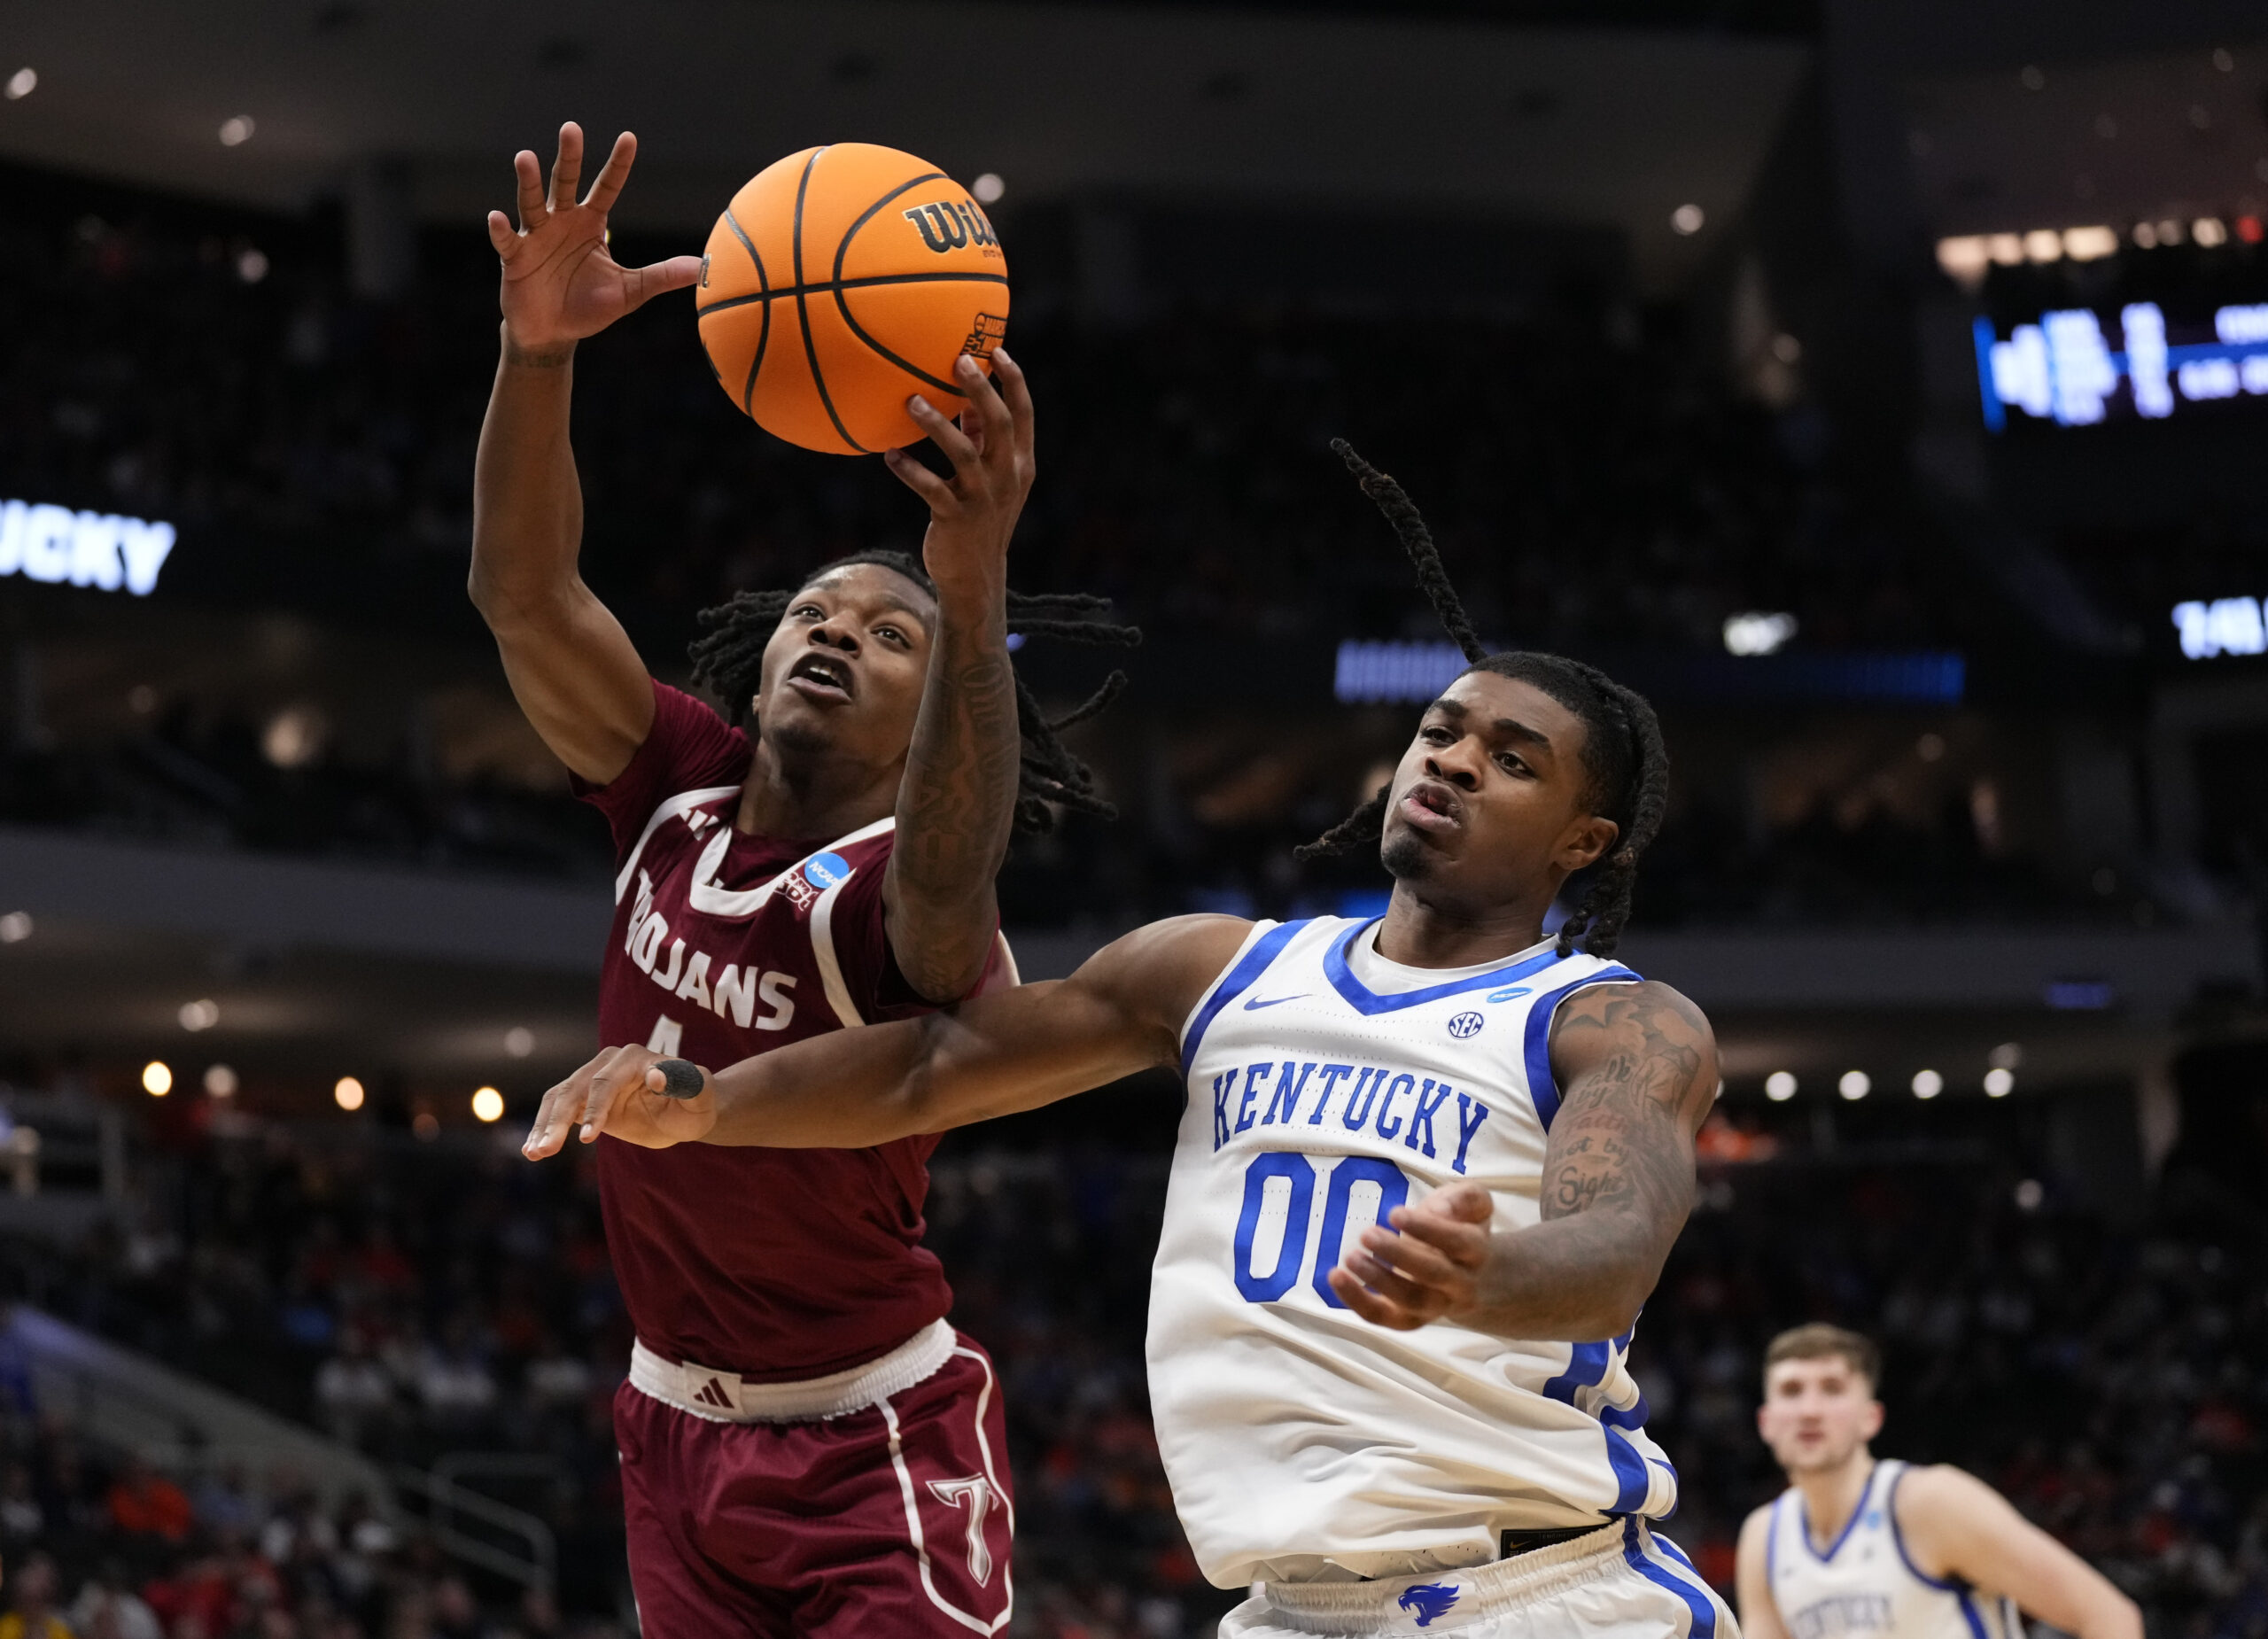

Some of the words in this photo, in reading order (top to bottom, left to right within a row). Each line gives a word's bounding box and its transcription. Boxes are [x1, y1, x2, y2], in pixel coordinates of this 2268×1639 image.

[624, 866, 797, 1031] TROJANS
[1449, 1013, 1483, 1038] SEC
[1213, 1061, 1489, 1176] KENTUCKY
[1233, 1152, 1410, 1309] 00
